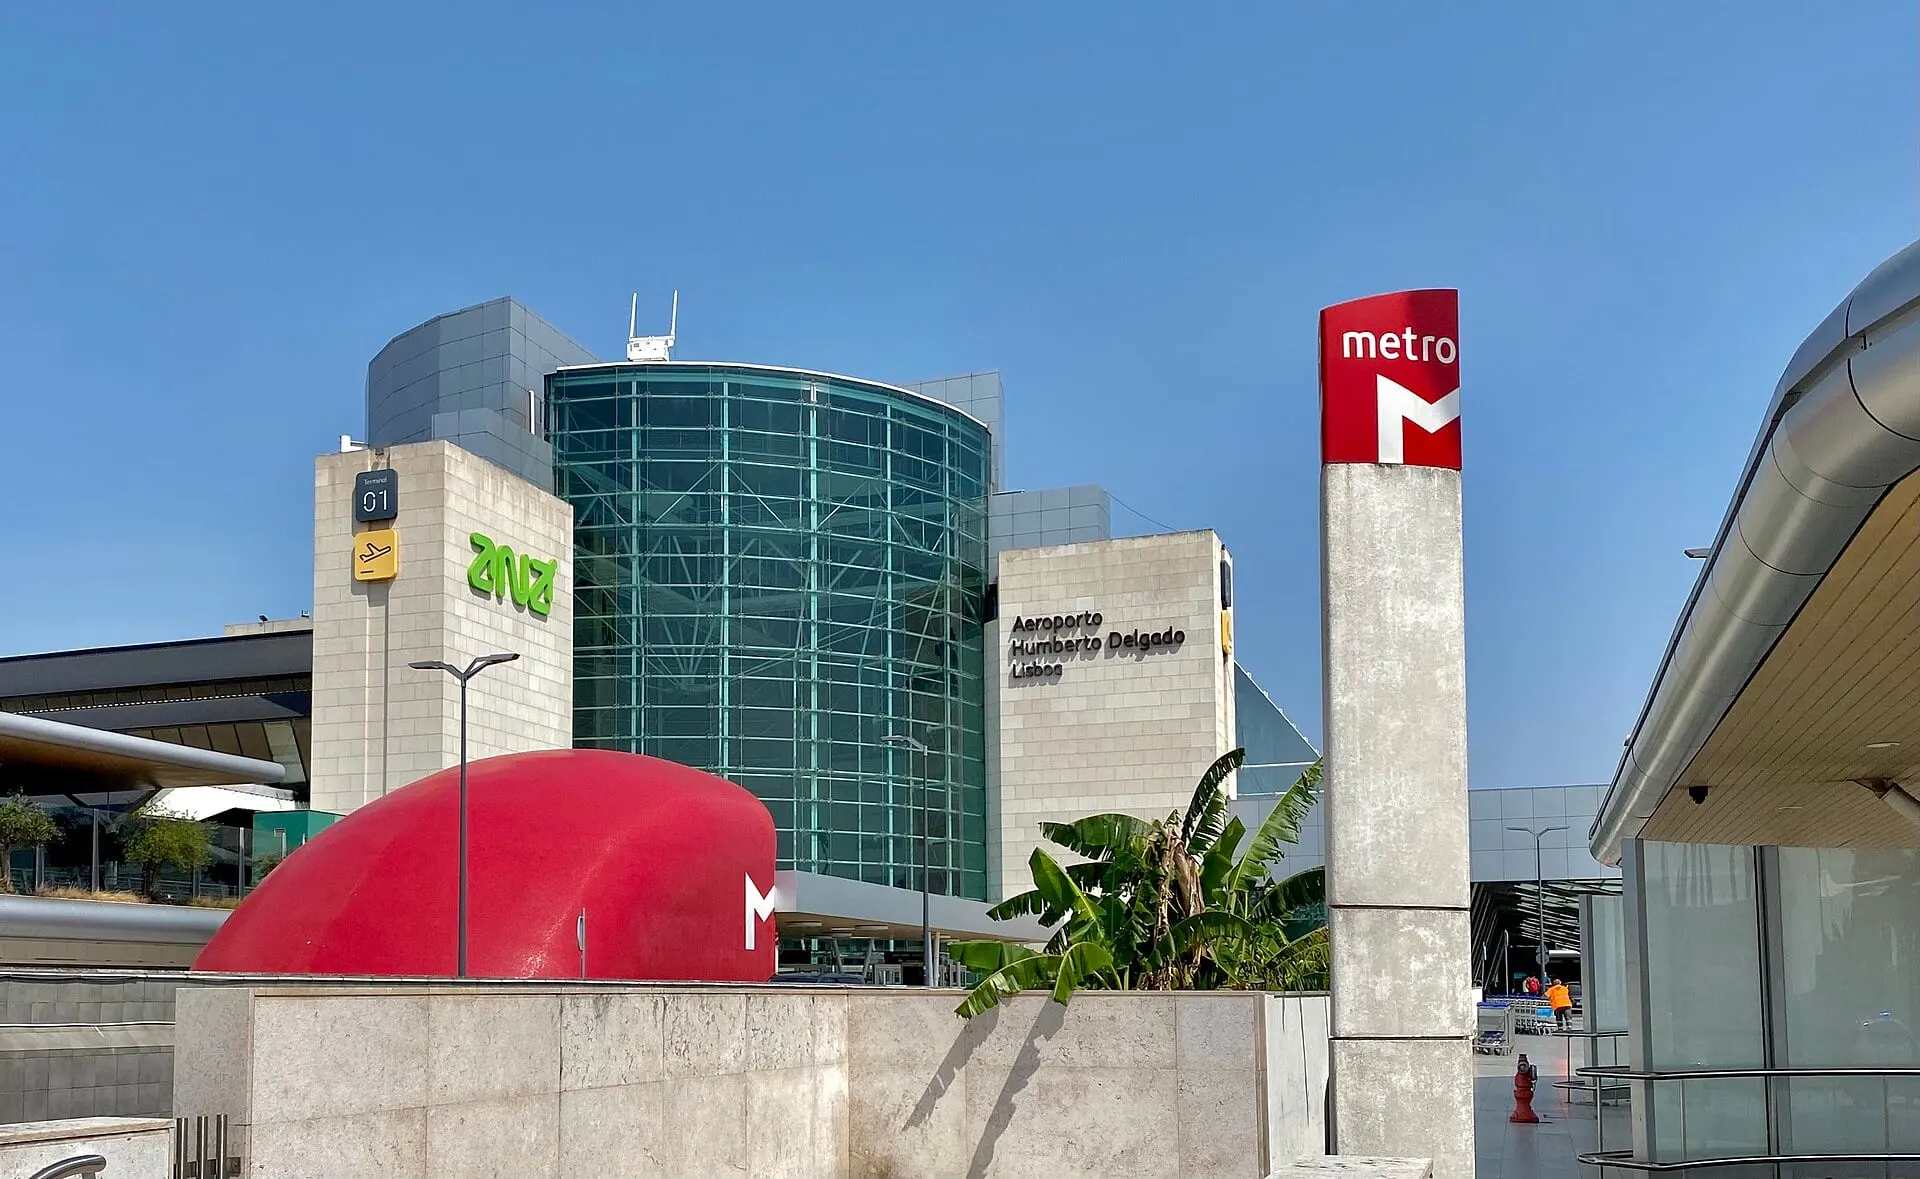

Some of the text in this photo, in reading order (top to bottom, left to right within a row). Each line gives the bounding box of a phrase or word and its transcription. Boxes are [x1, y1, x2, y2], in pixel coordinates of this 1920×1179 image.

[1342, 326, 1457, 364] metro
[1376, 373, 1460, 464] M
[364, 477, 387, 485] Terminal
[363, 490, 387, 512] 01
[1012, 611, 1103, 633] Aeroporto
[1012, 626, 1186, 656] Humberto Delgado
[1012, 661, 1063, 679] Lisboa
[745, 872, 775, 950] M
